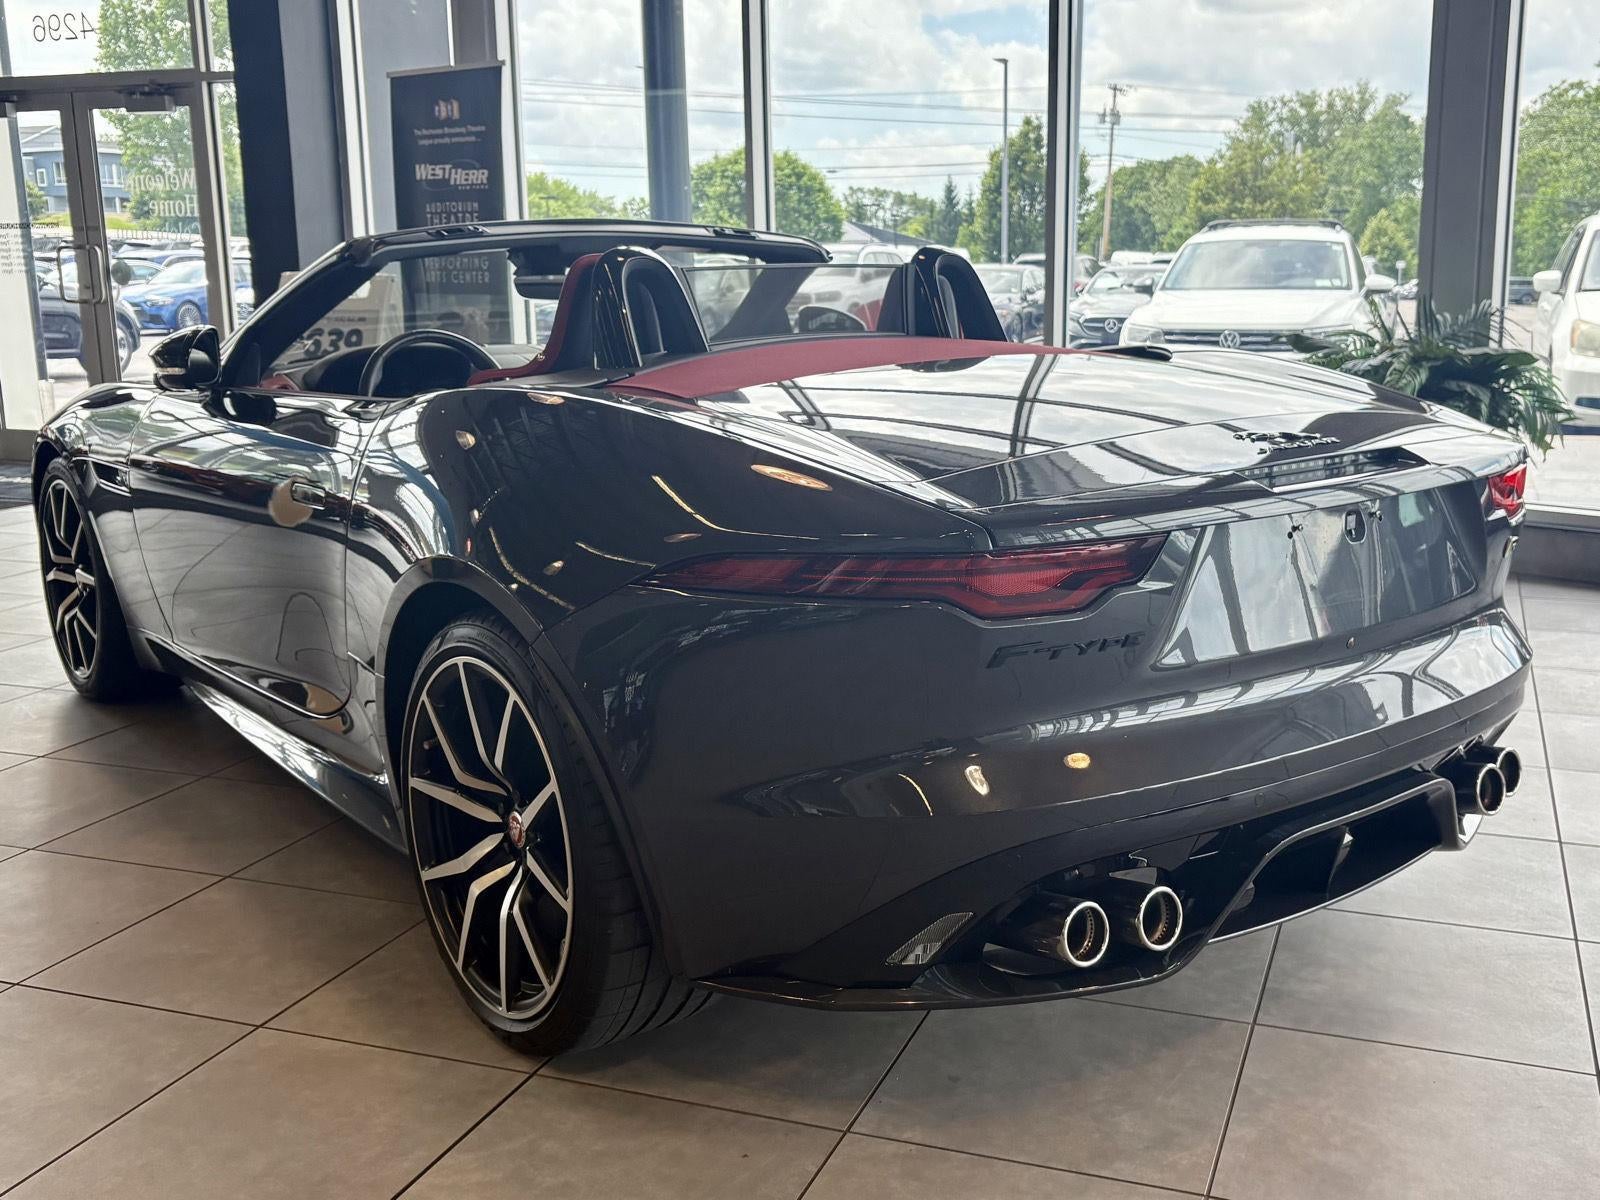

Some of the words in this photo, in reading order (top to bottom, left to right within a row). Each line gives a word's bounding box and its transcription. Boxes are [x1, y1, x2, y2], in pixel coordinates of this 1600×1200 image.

[415, 163, 453, 180] WEST
[450, 168, 489, 185] HERR
[425, 201, 479, 212] AUDITORIUM
[451, 271, 490, 284] CENTER
[985, 631, 1146, 669] F-TYPE
